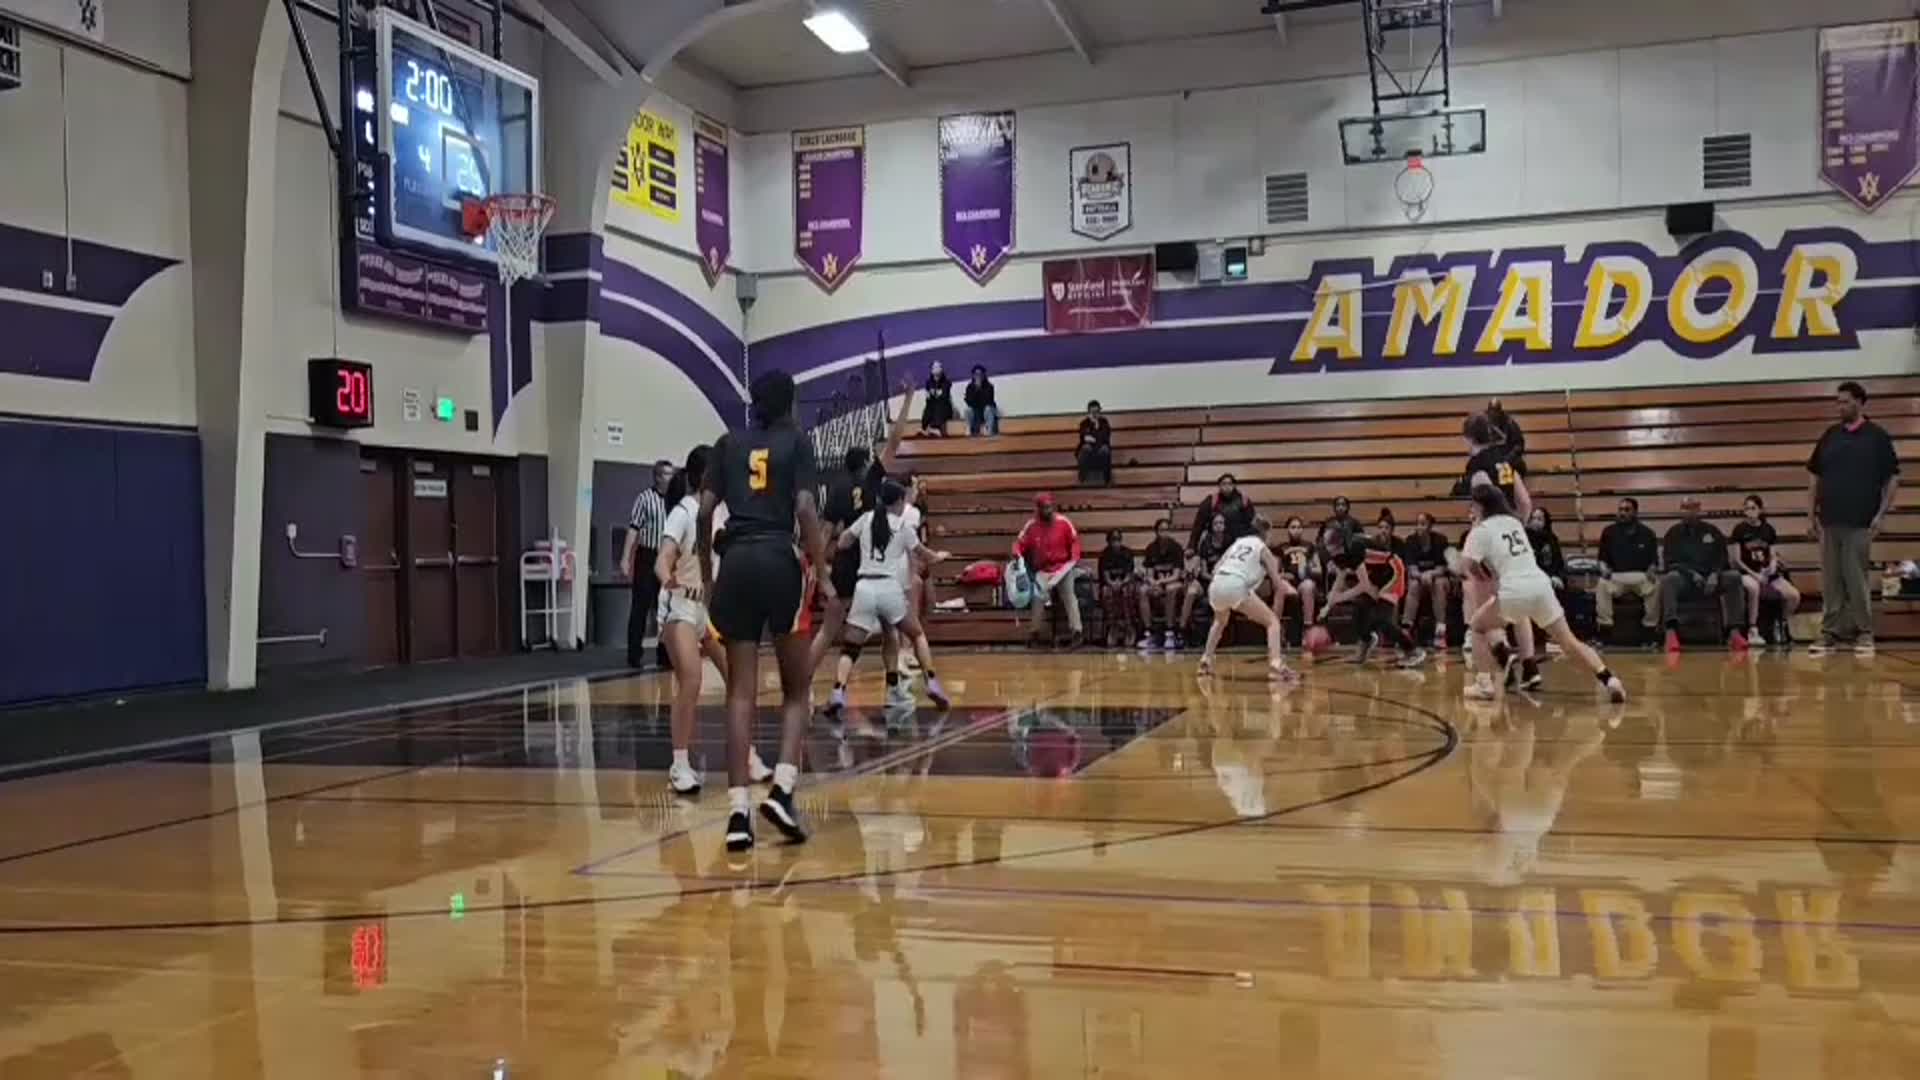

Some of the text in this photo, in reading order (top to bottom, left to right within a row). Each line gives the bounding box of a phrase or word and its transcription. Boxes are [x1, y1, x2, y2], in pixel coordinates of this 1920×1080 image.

[405, 60, 453, 116] 2:00
[1289, 242, 1858, 362] AMADOR
[336, 369, 366, 413] 20
[748, 447, 770, 491] 5
[1501, 529, 1529, 557] 25
